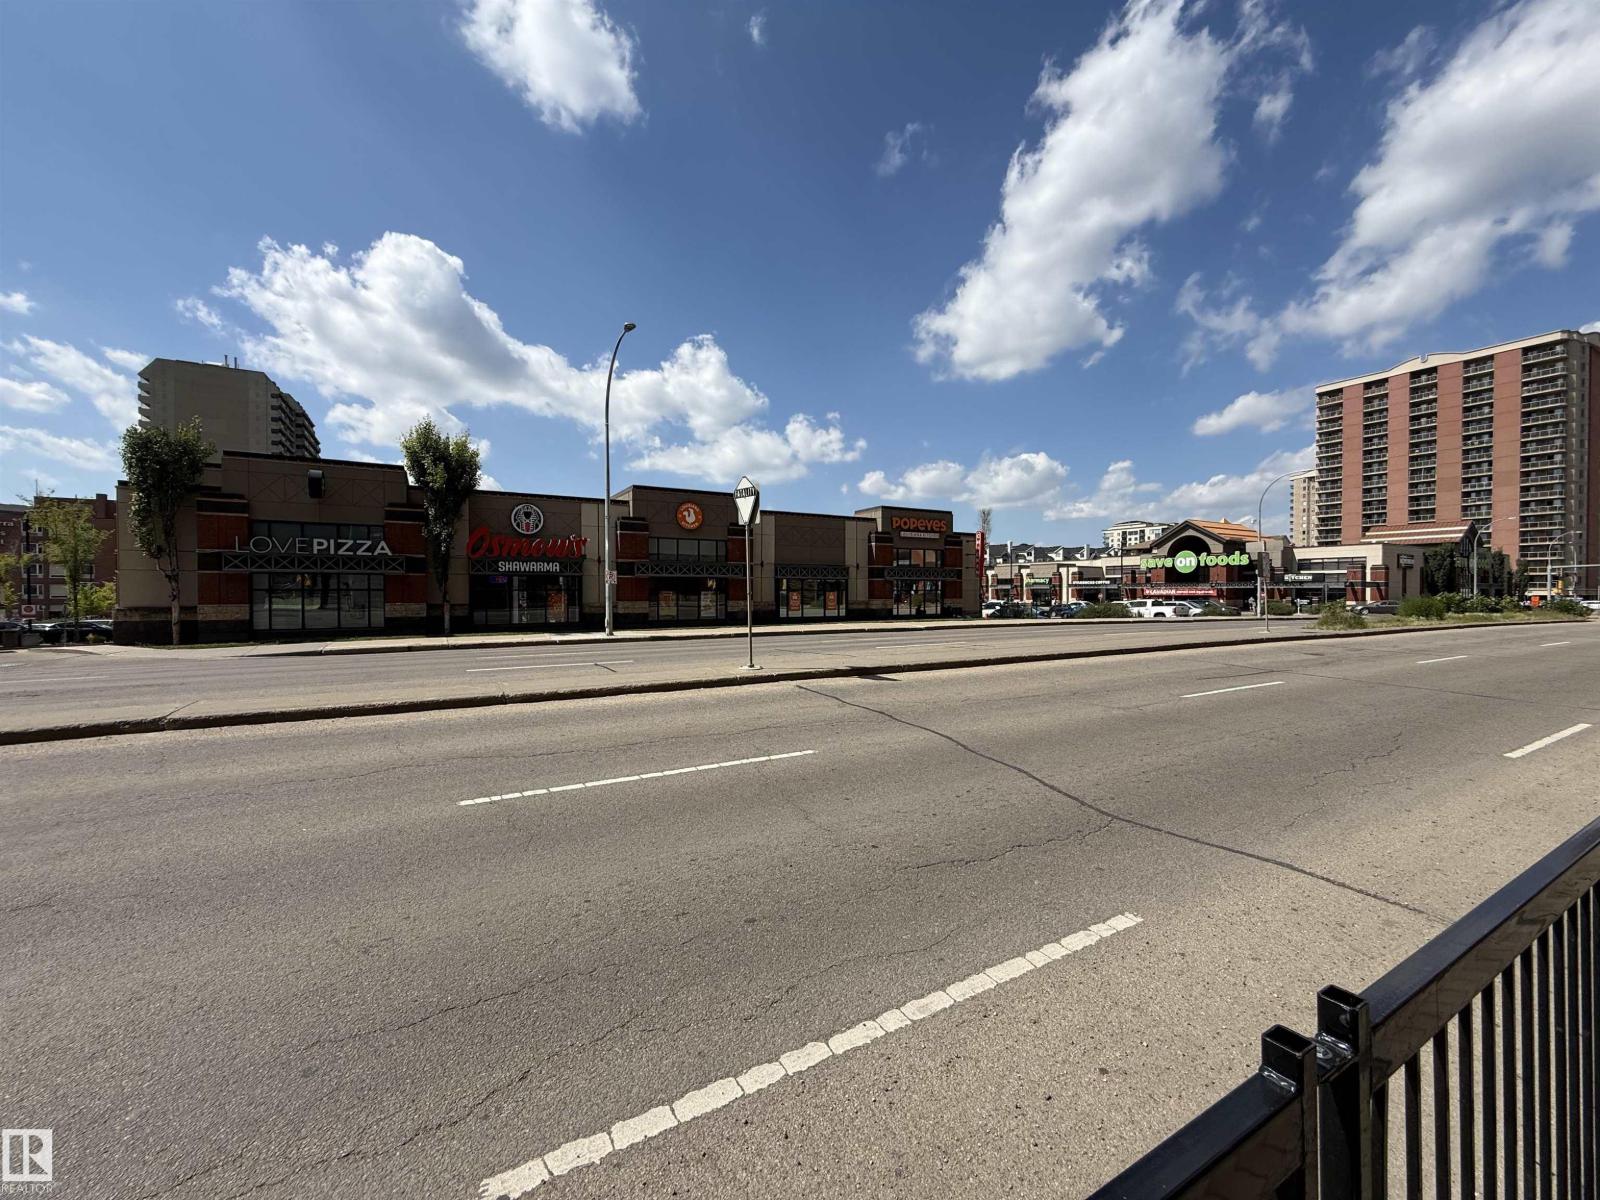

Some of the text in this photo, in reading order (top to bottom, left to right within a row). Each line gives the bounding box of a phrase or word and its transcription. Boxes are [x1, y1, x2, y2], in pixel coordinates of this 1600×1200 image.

[498, 560, 560, 572] SHAWARMA
[1140, 551, 1250, 569] save on foods
